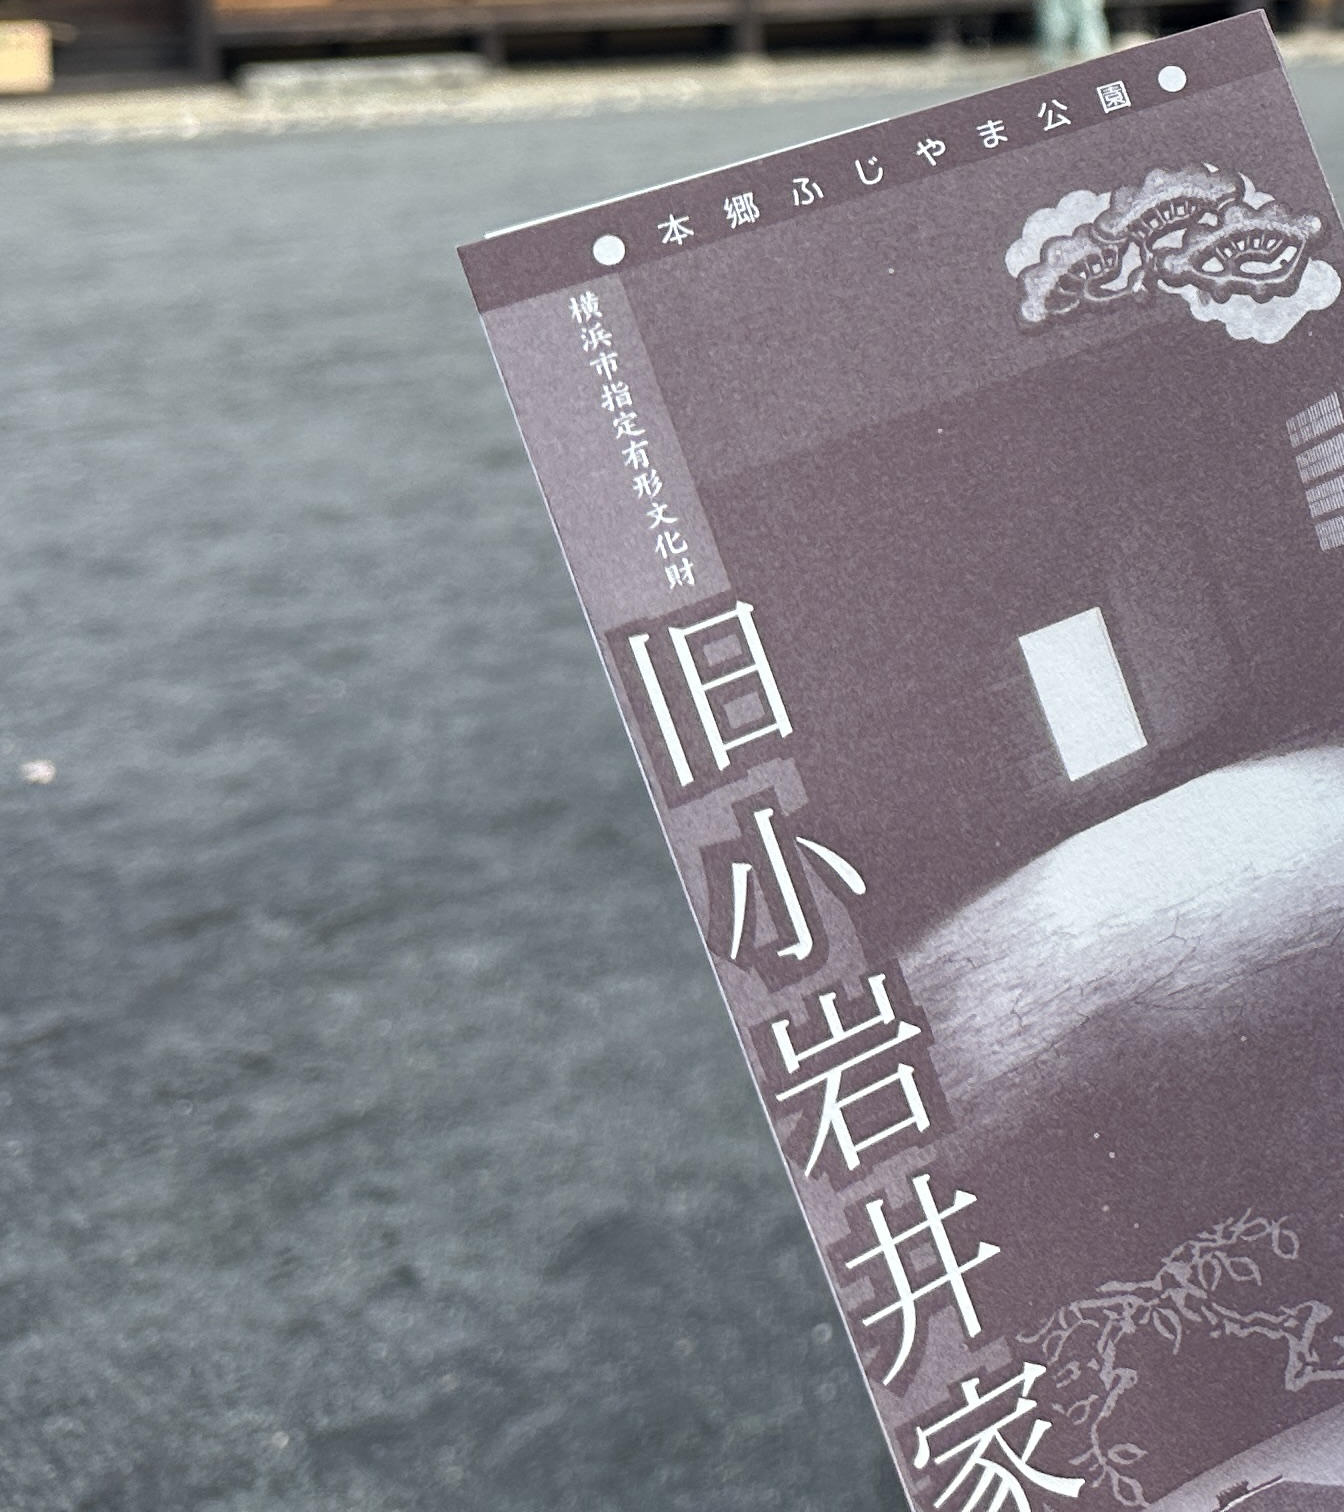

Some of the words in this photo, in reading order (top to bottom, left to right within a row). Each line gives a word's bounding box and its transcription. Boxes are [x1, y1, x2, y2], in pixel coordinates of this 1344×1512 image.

[657, 81, 1131, 246] 本郷ふじやま公園
[568, 290, 696, 590] 横浜市指定有形文化財
[628, 600, 1085, 1512] 旧小岩井家
